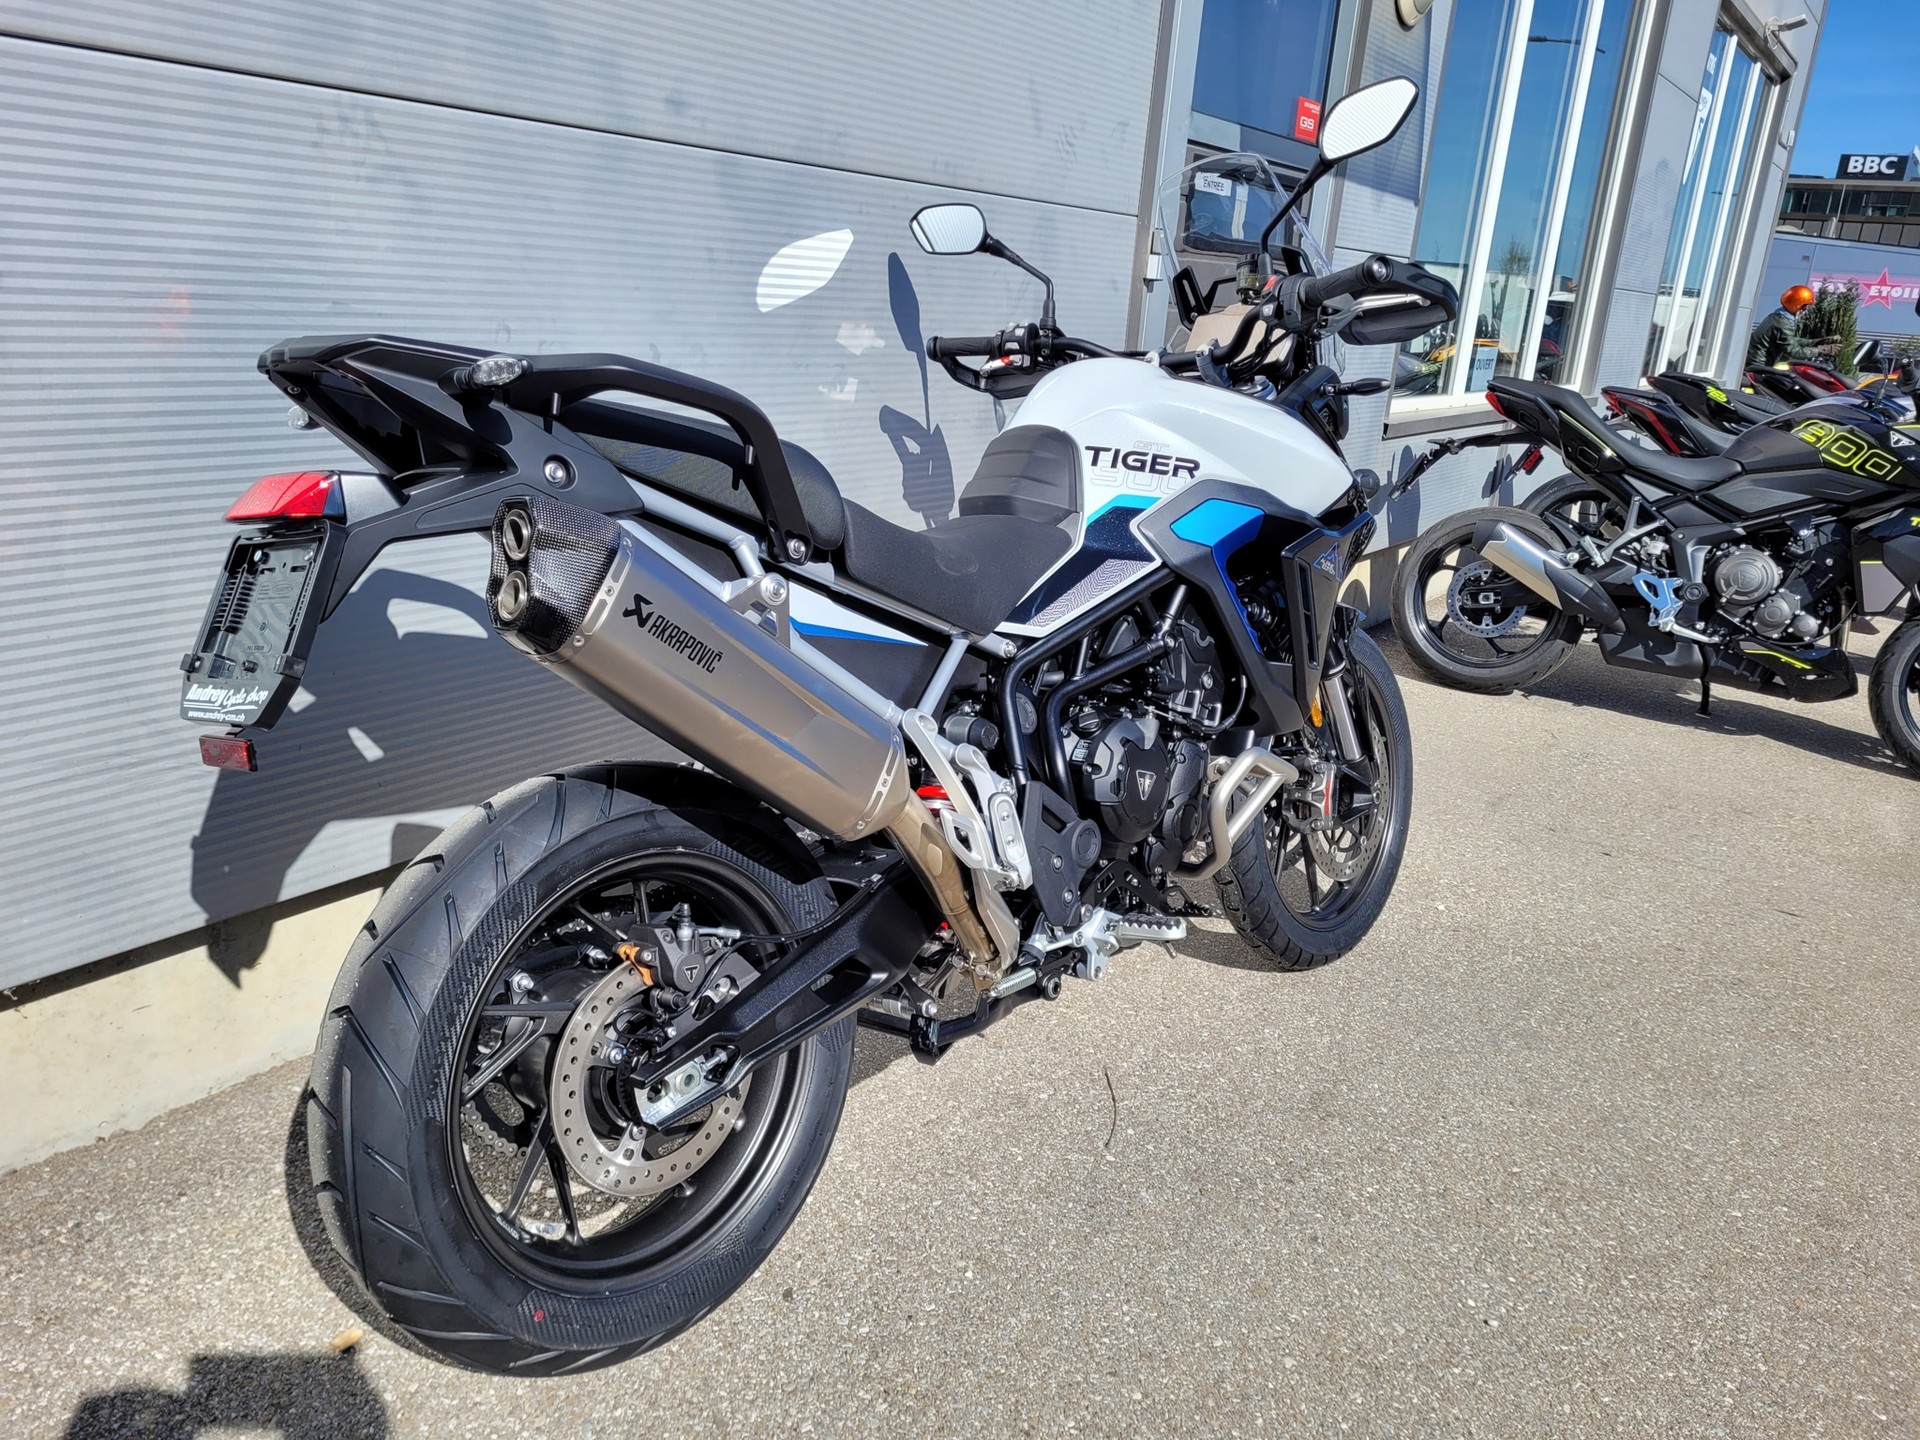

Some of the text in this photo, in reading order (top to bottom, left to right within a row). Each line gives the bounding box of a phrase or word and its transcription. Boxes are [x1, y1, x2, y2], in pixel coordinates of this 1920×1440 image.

[1300, 116, 1315, 130] GS
[1847, 156, 1898, 174] BBC
[1869, 285, 1920, 299] ETOIL
[1475, 358, 1494, 371] OUVERT
[1084, 445, 1201, 480] TIGER
[185, 683, 229, 707] Andrey
[187, 710, 246, 722] www.andrey-cm.ch
